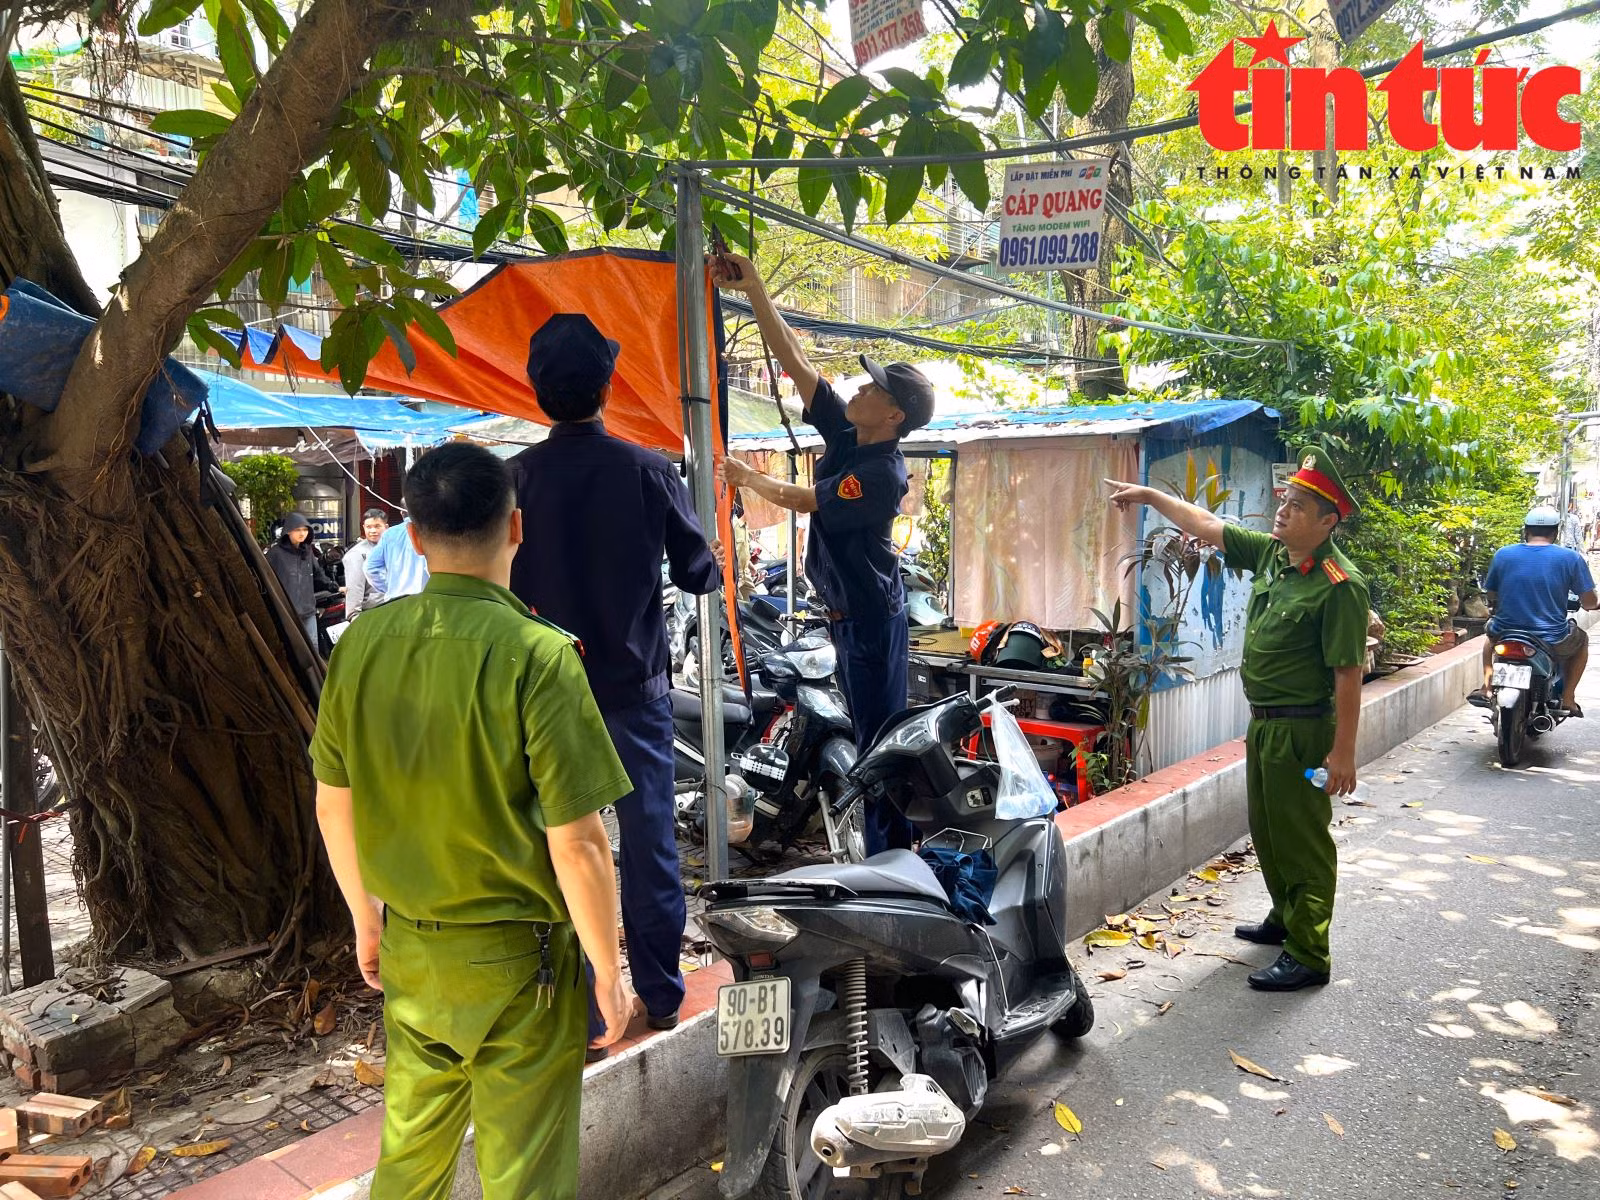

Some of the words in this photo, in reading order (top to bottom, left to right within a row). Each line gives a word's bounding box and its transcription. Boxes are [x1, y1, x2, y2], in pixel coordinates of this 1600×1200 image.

[1335, 0, 1385, 39] 0972.
[1005, 188, 1039, 217] CÁP
[1042, 188, 1103, 219] QUANG
[1038, 221, 1071, 232] MODEM
[1072, 219, 1091, 230] WIFI
[1000, 231, 1100, 268] 0961.099.288
[727, 983, 778, 1018] 90-B1
[720, 1016, 784, 1051] 578.39
